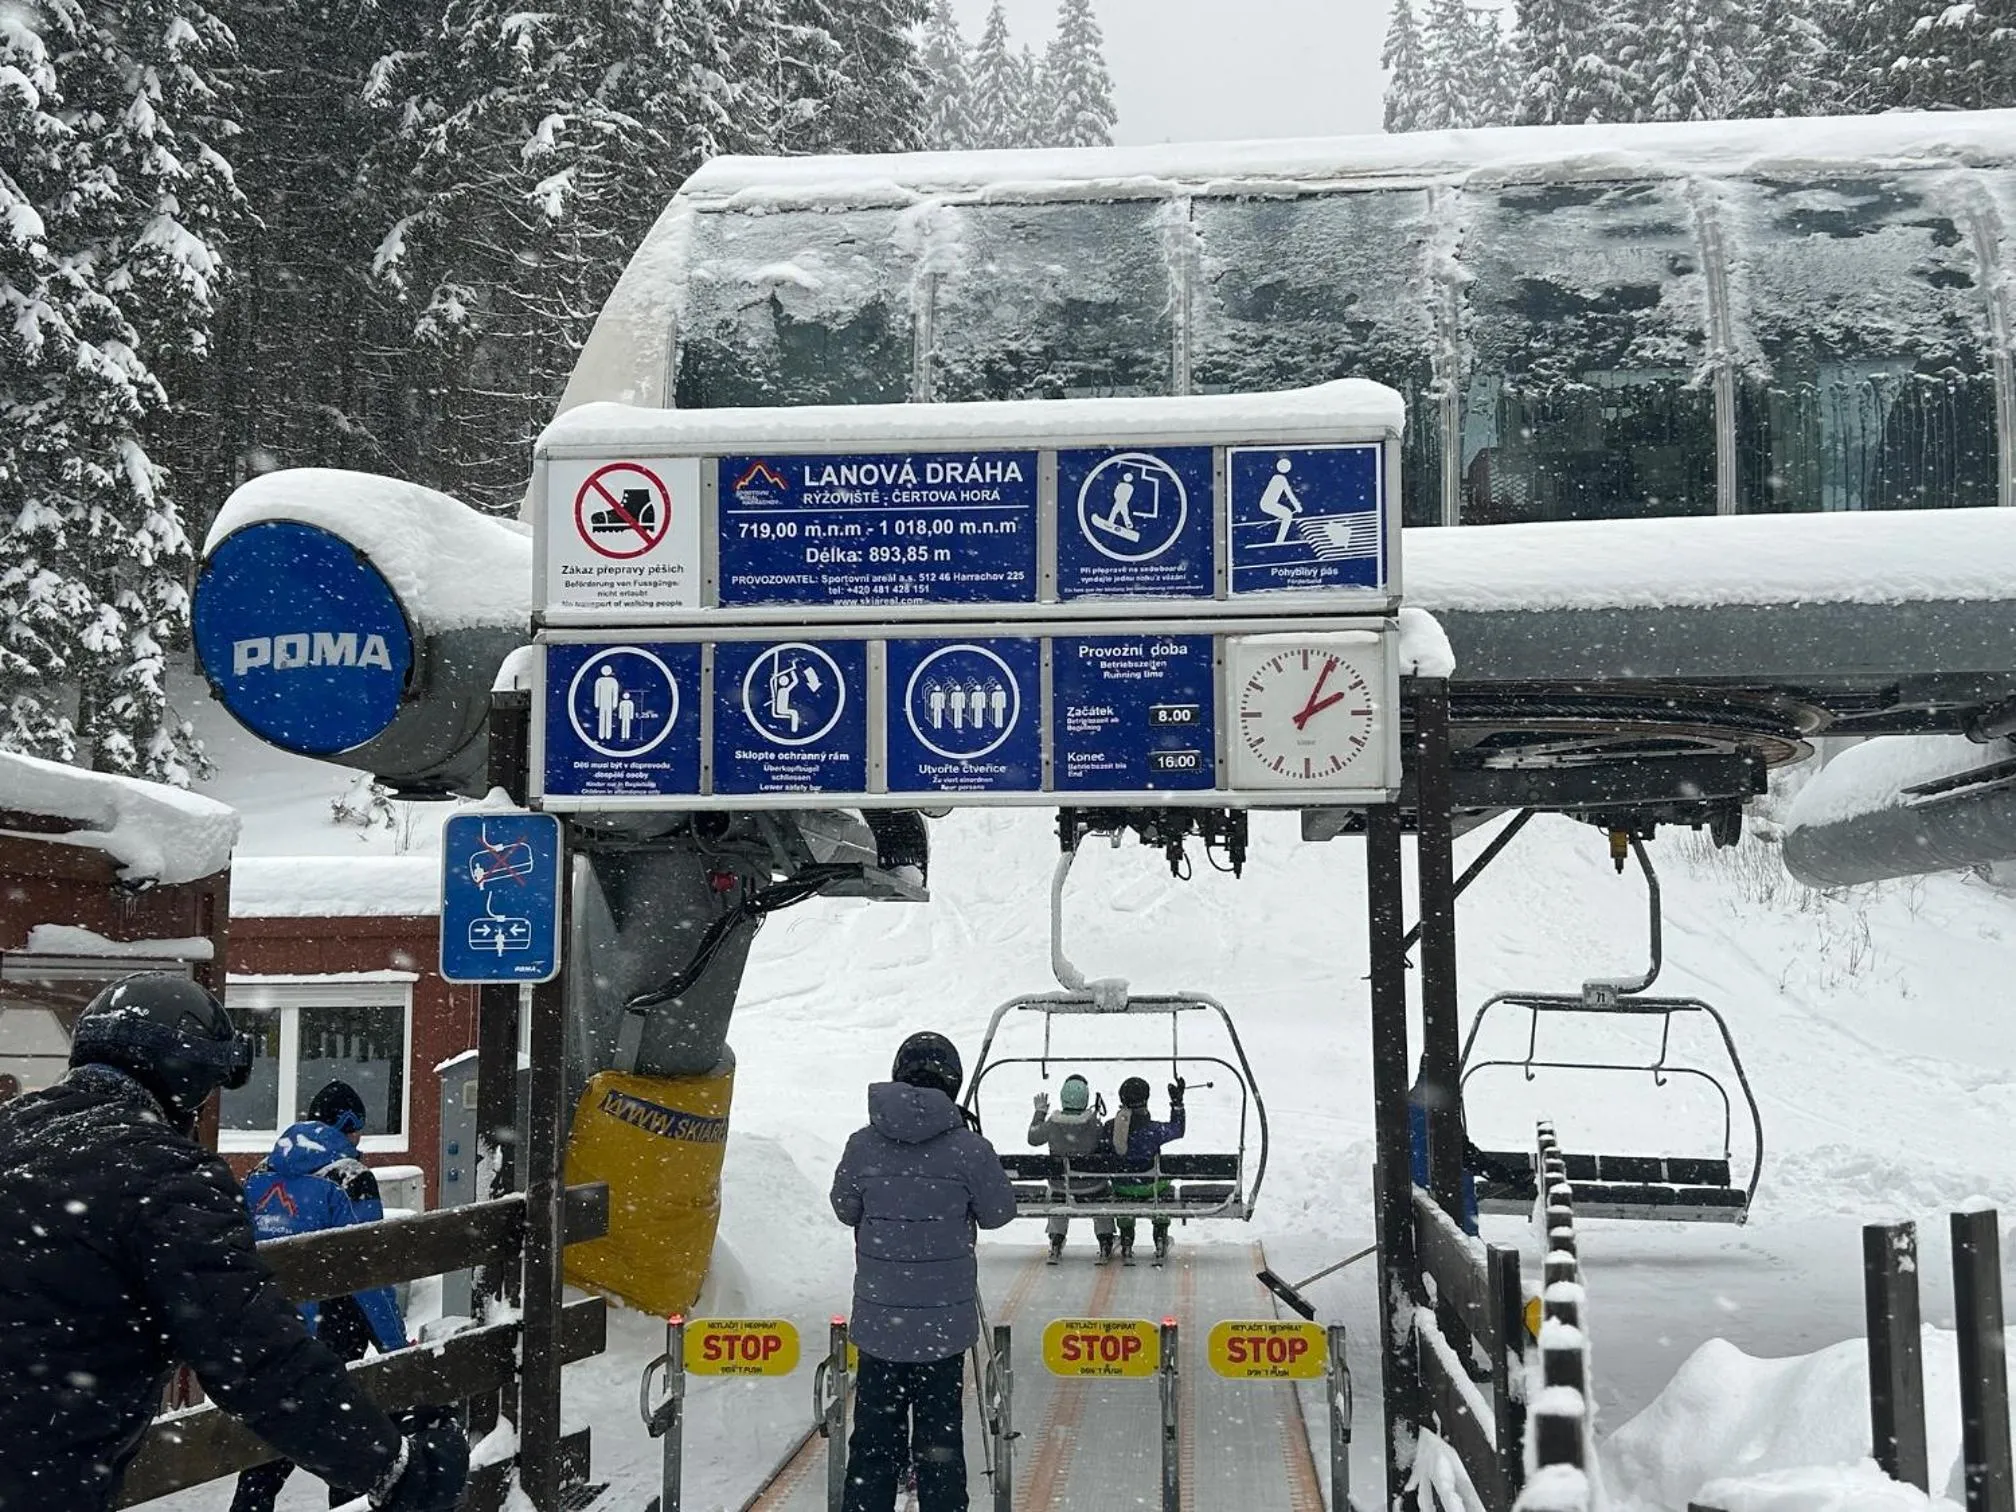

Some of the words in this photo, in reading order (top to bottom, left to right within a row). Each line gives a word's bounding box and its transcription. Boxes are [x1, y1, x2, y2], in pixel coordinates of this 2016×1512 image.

[804, 457, 917, 486] LANOVÁ
[926, 456, 1023, 484] DRÁHA
[892, 489, 957, 502] ČERTOVA
[739, 522, 797, 540] 719,00
[804, 524, 861, 537] m.n.m
[960, 521, 1016, 534] m.n.m
[806, 546, 862, 563] Délka:
[869, 546, 928, 564] 893,85
[934, 548, 951, 561] m
[561, 565, 593, 575] Zákaz
[597, 564, 645, 576] přepravy
[731, 575, 818, 585] PROVOZOVATEL:
[919, 572, 936, 581] 512
[939, 572, 951, 581] 46
[953, 571, 1005, 581] Harrachov
[1007, 571, 1025, 580] 225
[233, 632, 392, 676] POMA
[1150, 642, 1188, 656] doba
[1066, 705, 1114, 717] Začátek
[1158, 709, 1191, 722] 8.00
[735, 750, 775, 760] Sklopte
[777, 750, 827, 762] ochranný
[828, 750, 849, 760] rám
[1067, 752, 1105, 762] Konec
[1159, 755, 1196, 768] 16.00
[702, 1335, 782, 1361] STOP
[1061, 1335, 1142, 1361] STOP
[1227, 1336, 1308, 1363] STOP
